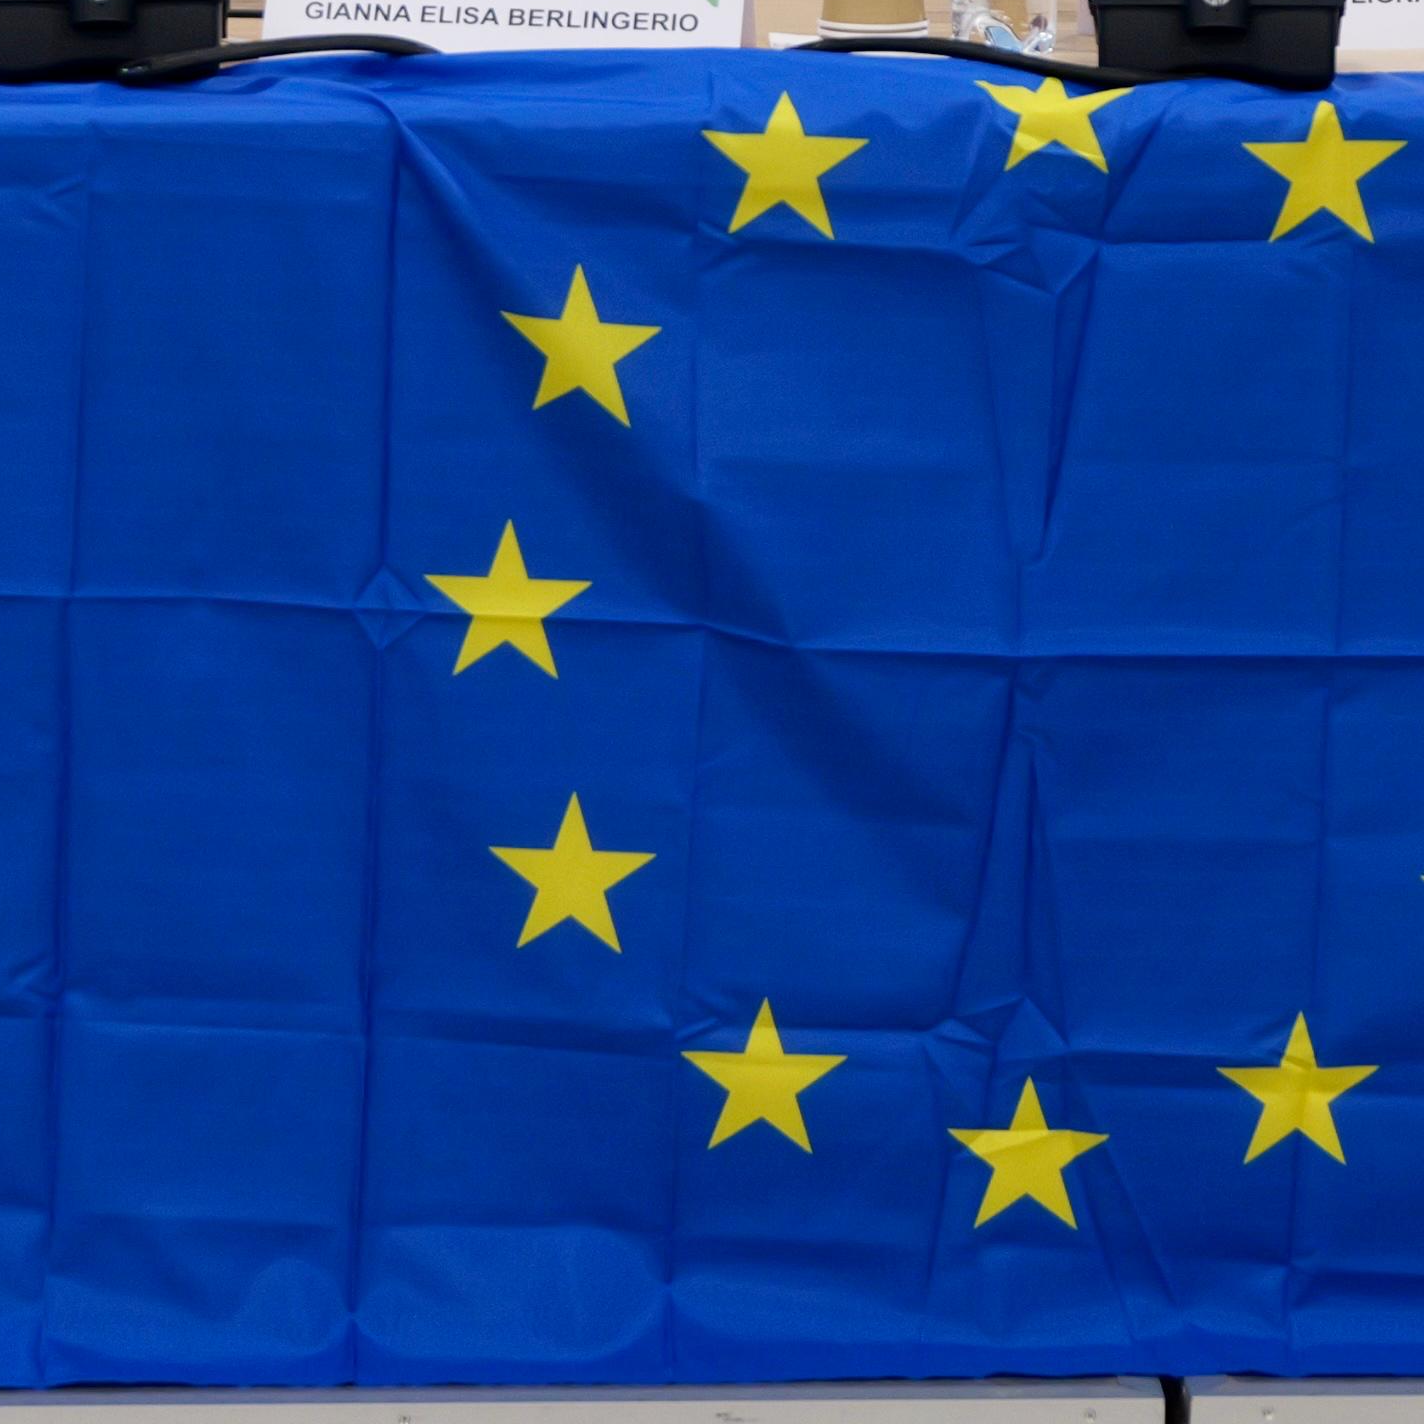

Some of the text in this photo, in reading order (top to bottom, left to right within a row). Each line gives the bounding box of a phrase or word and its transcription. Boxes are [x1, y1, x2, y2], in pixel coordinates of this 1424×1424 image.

[305, 1, 699, 32] GIANNA ELISA BERLINGERIO
